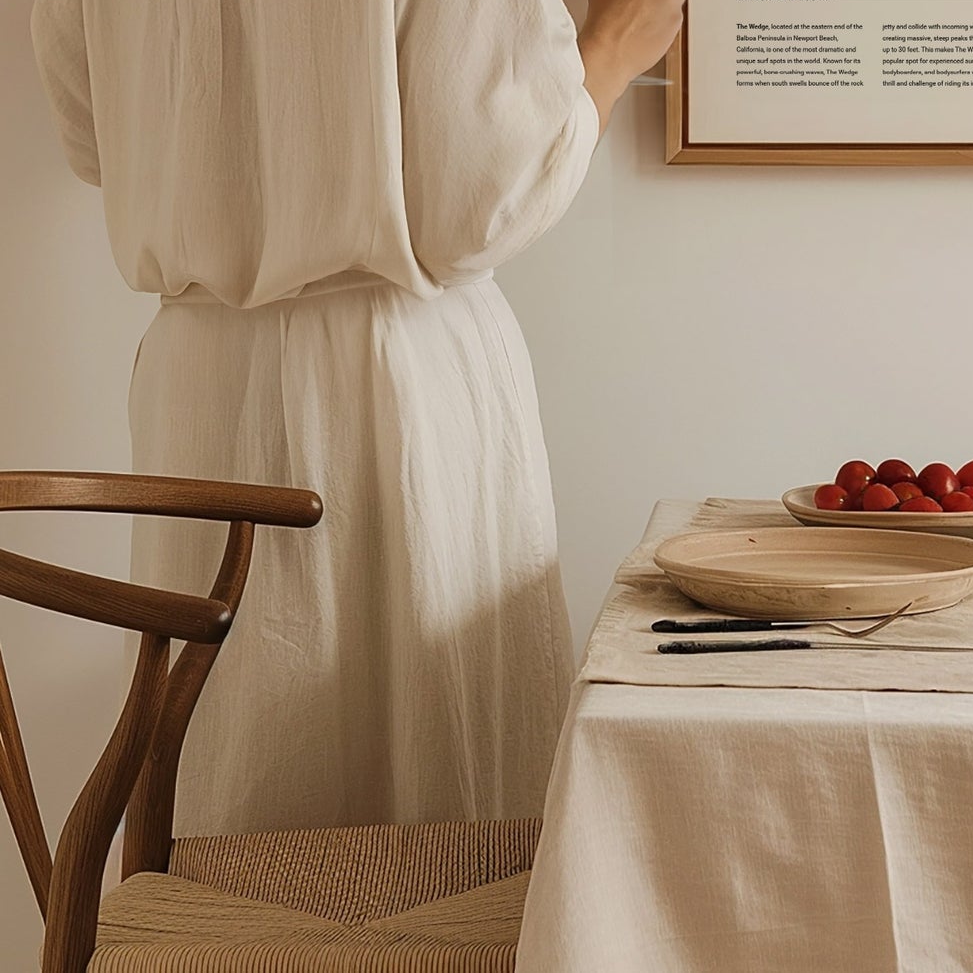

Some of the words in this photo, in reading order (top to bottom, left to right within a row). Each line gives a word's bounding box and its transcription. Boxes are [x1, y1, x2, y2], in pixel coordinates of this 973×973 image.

[748, 23, 770, 31] Wedge,
[882, 23, 895, 31] jetty
[942, 23, 968, 31] incoming
[793, 35, 818, 43] Newport
[882, 35, 906, 43] creating
[934, 35, 950, 43] steep
[951, 35, 968, 43] peaks
[736, 46, 765, 54] California,
[736, 69, 763, 77] powerful,
[838, 69, 858, 77] Wedge
[909, 80, 936, 88] challenge
[945, 80, 961, 88] riding
